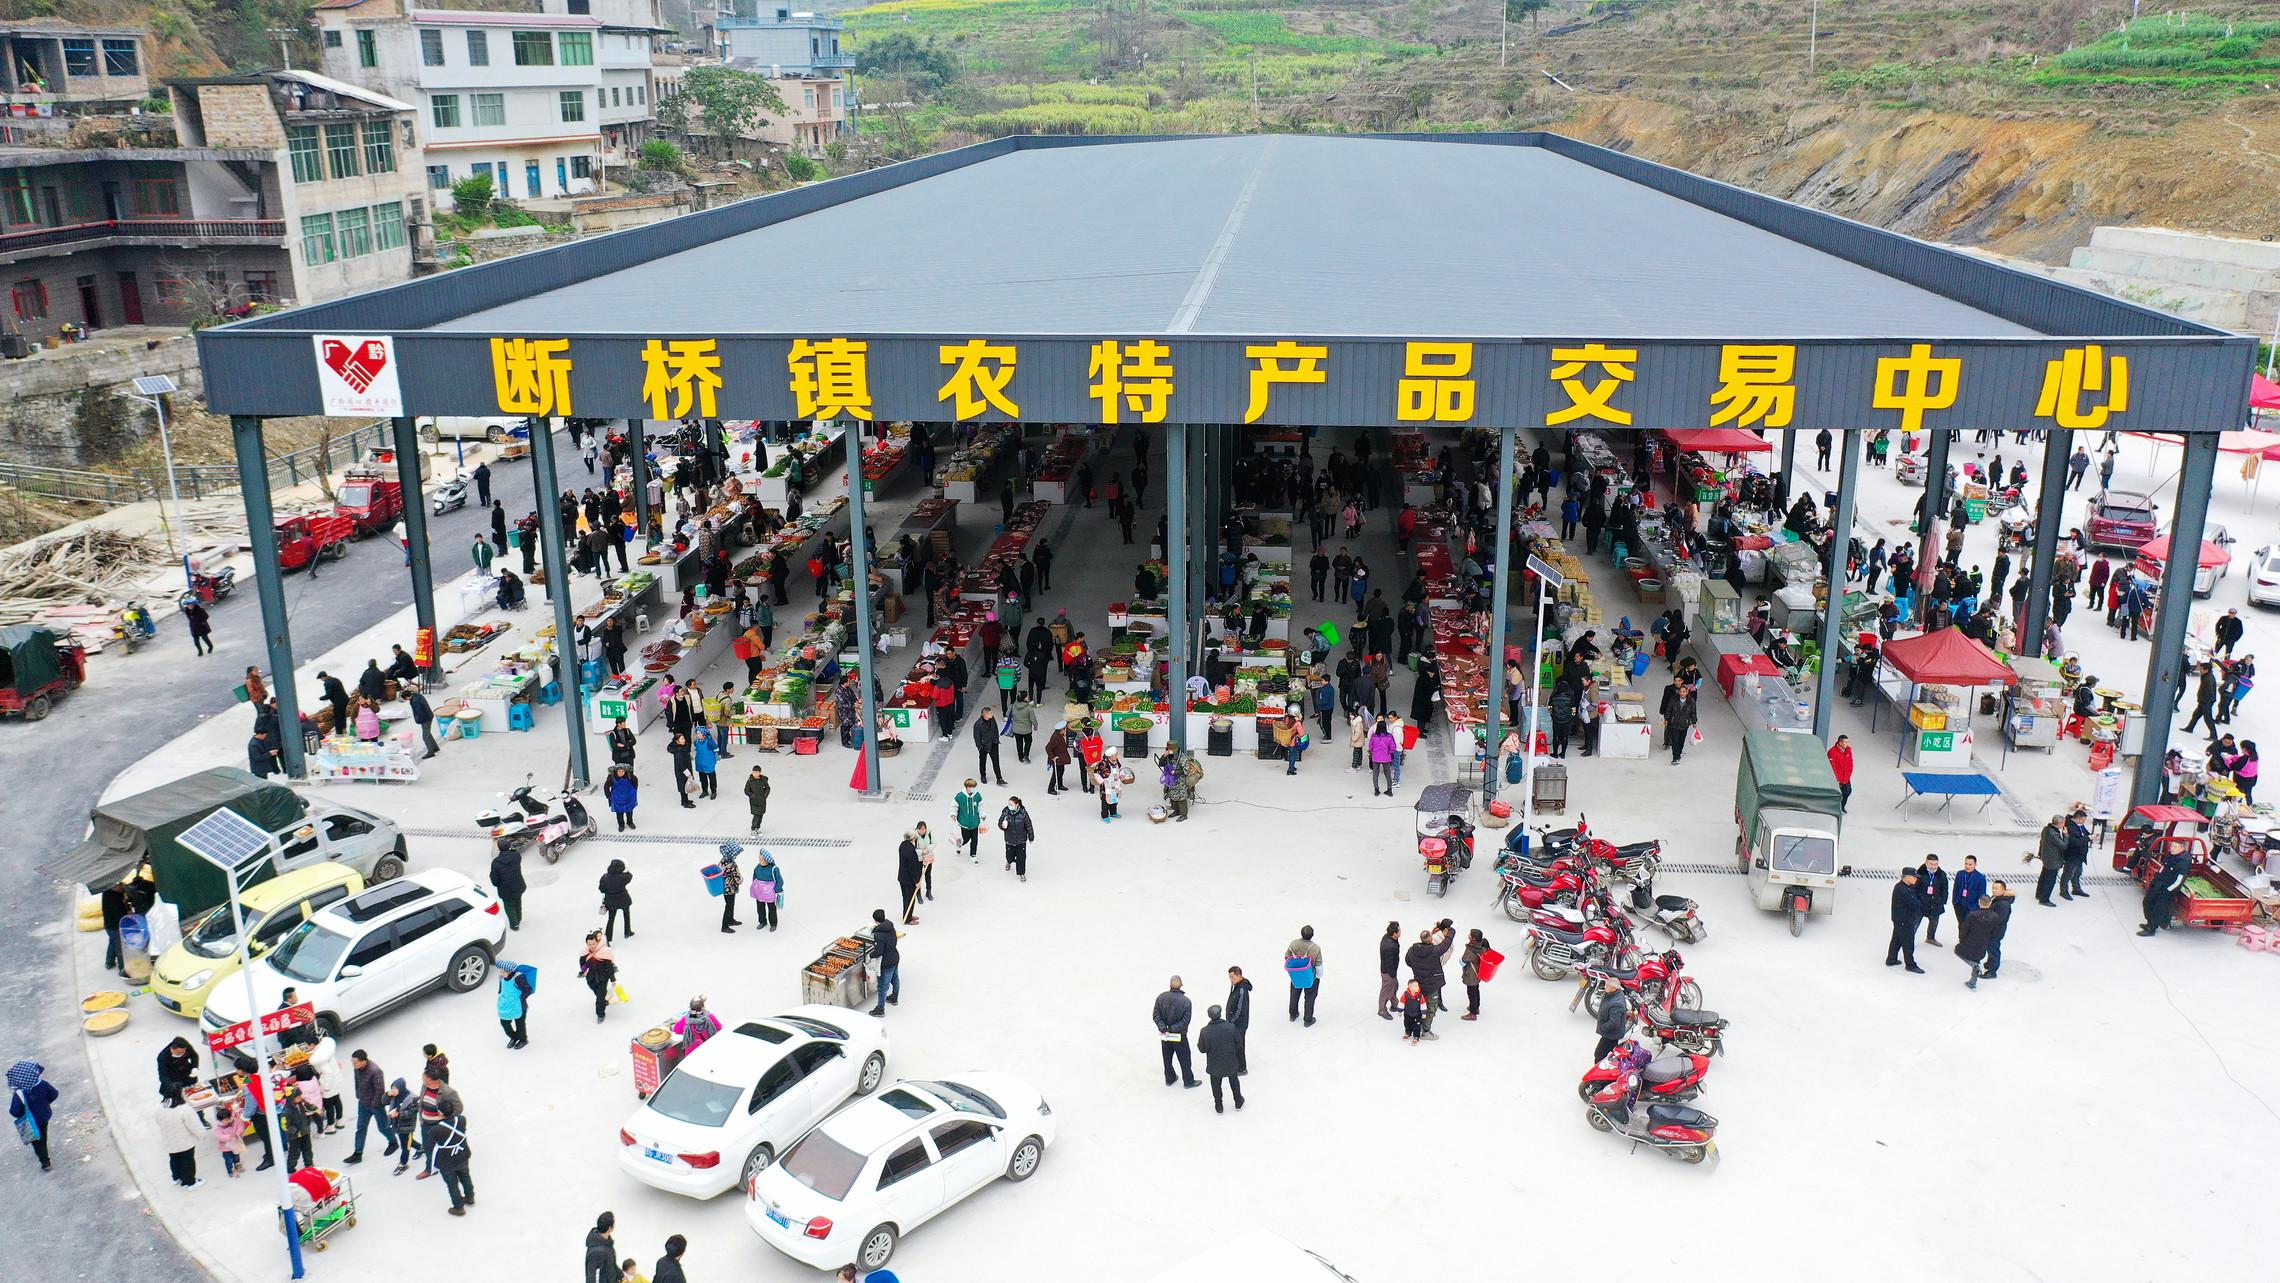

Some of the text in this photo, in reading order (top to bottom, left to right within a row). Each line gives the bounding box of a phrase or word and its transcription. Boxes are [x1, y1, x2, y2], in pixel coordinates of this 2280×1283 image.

[324, 343, 340, 360] 广
[491, 338, 2128, 431] 断桥镇农特产品交易中心
[1923, 736, 1952, 748] 小吃区
